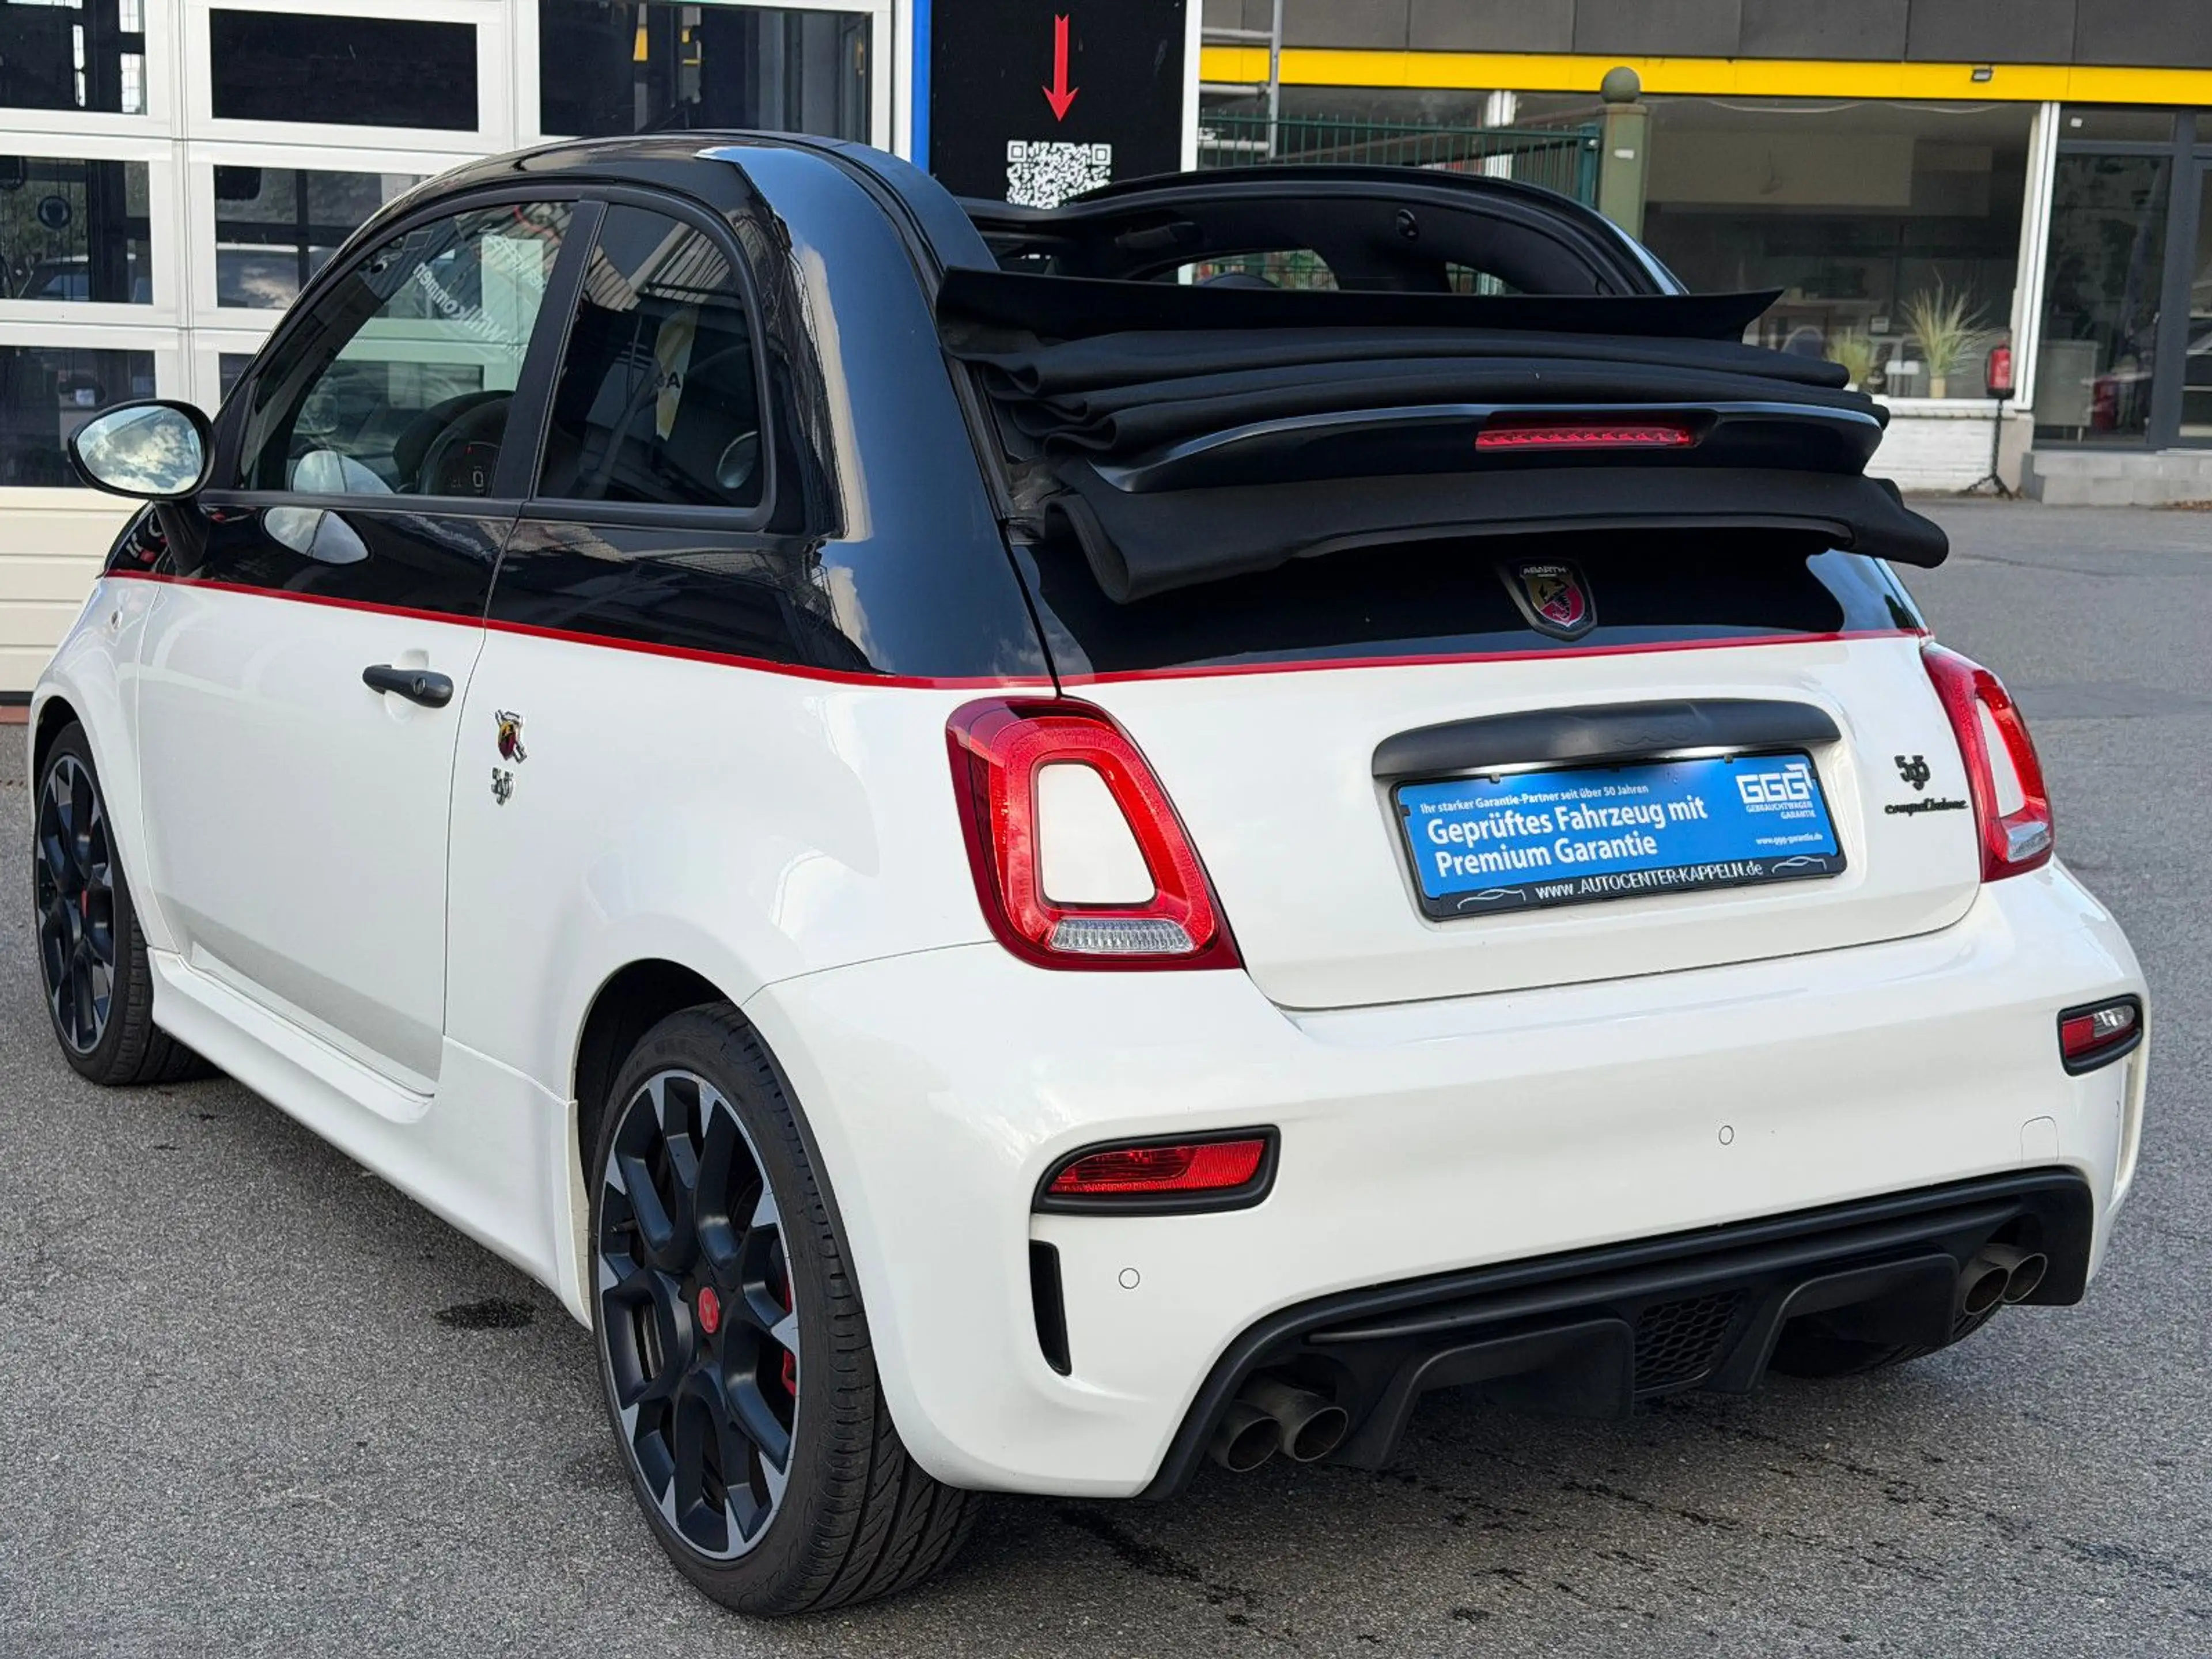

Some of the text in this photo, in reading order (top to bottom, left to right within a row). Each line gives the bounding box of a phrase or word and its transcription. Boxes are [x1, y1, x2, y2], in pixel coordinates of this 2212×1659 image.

[1421, 783, 1649, 814] Ihr starker Garantie-Partner seit über 50 Jahren
[1735, 768, 1812, 804] GGG
[1427, 794, 1709, 849] Geprüftes Fahrzeug mit
[1434, 830, 1658, 877] Premium Garantie
